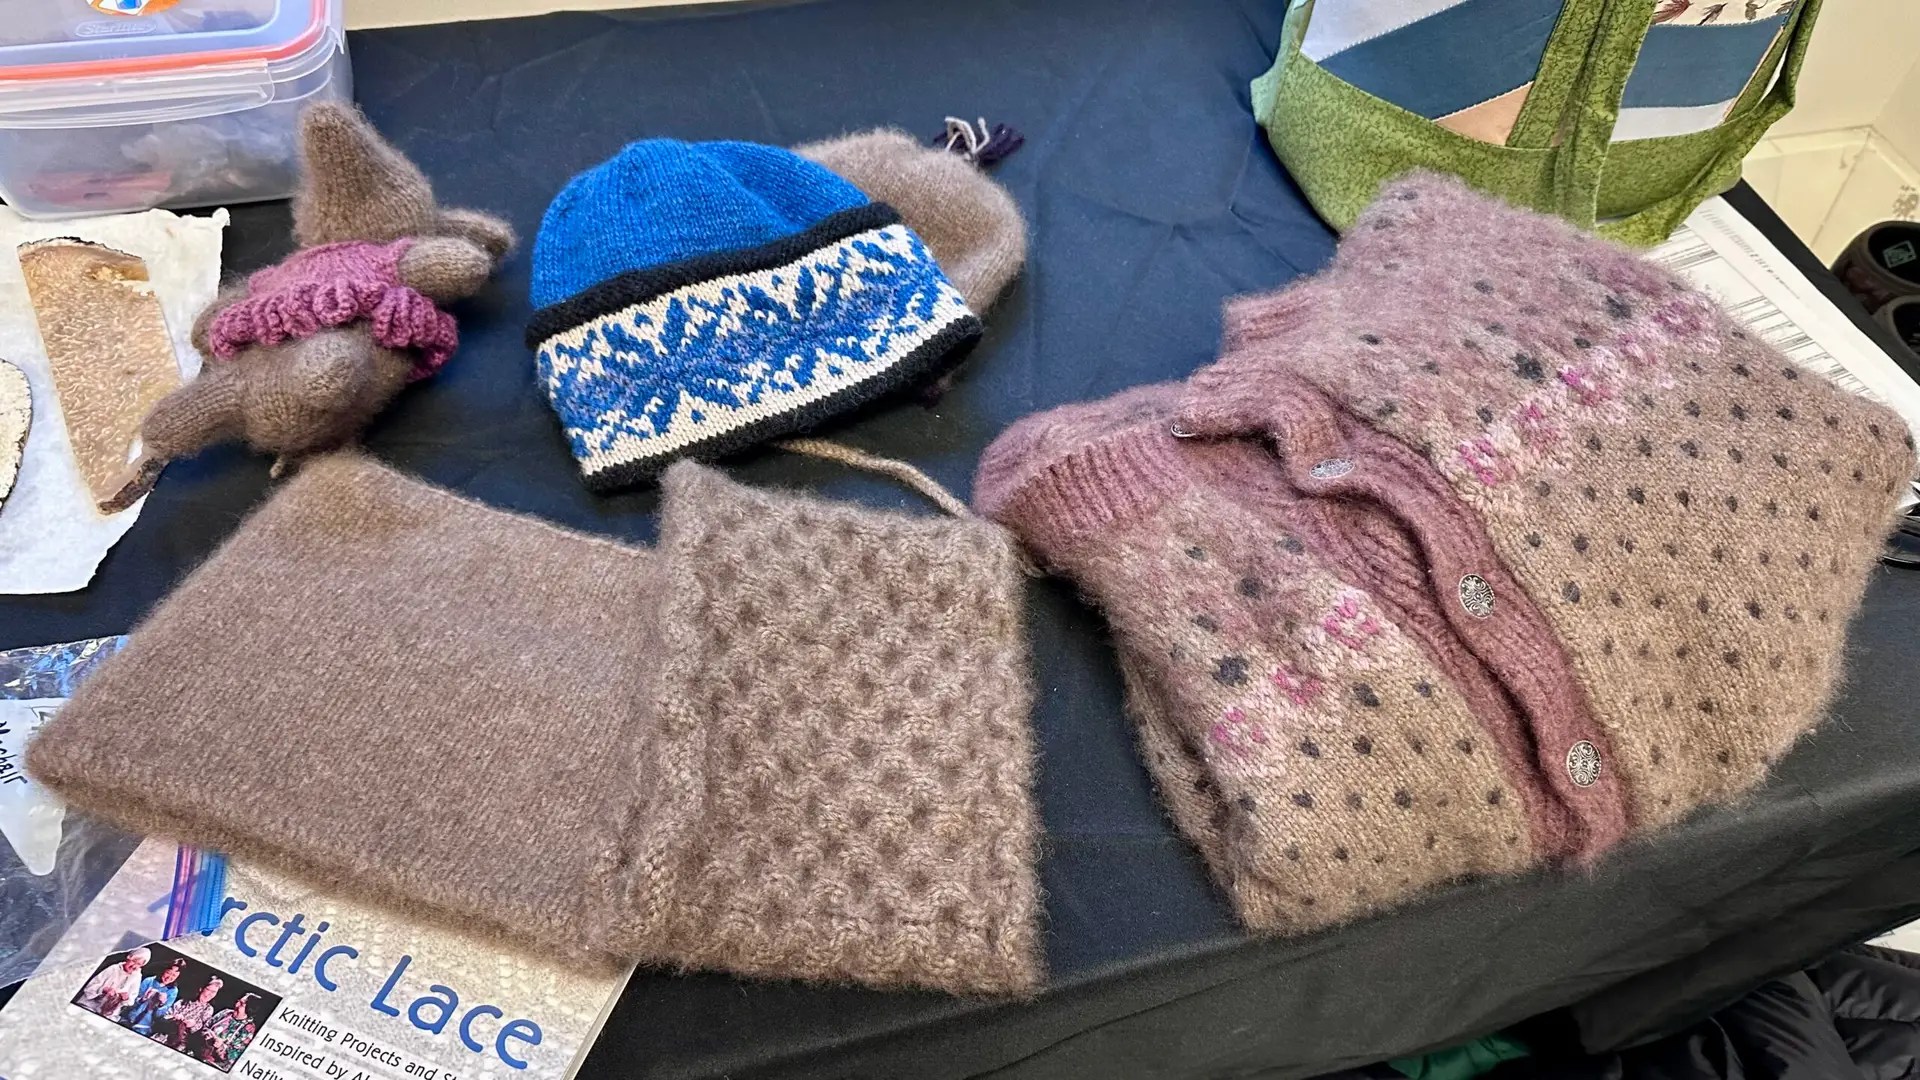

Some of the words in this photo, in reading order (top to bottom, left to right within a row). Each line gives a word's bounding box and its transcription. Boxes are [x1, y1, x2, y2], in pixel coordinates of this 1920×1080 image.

[278, 1007, 338, 1042] Knitting
[340, 1032, 402, 1067] Projects
[404, 1062, 439, 1080] and
[370, 955, 543, 1070] Lace
[259, 1032, 326, 1070] Inspired
[326, 1060, 349, 1080] by
